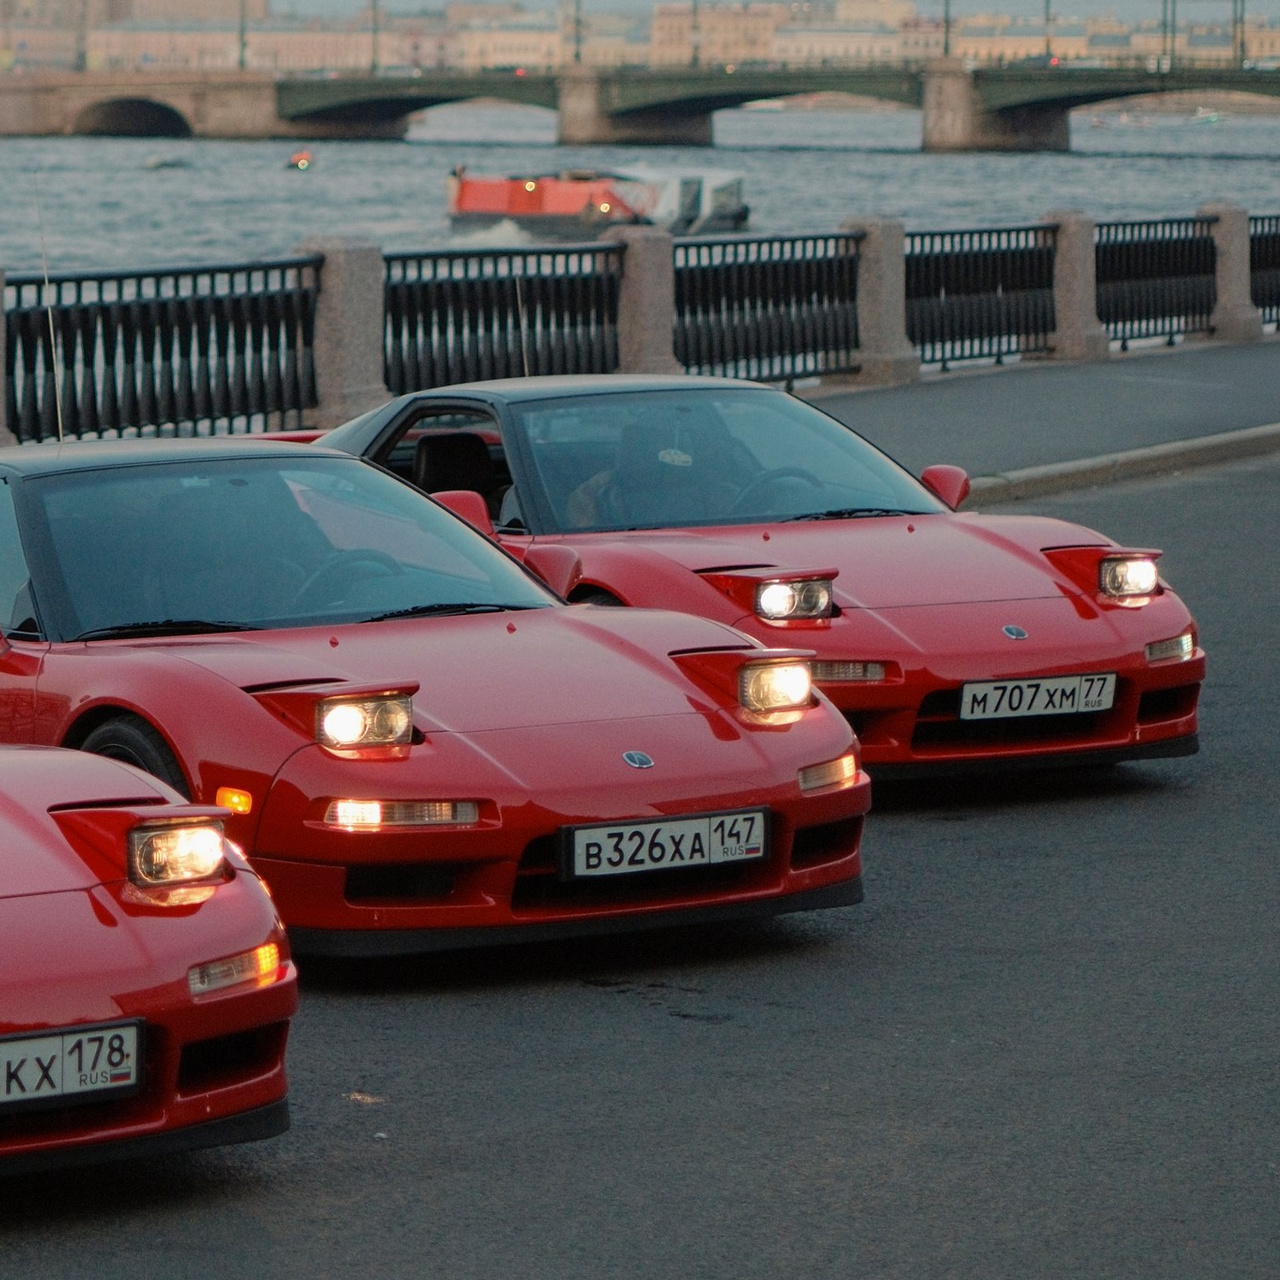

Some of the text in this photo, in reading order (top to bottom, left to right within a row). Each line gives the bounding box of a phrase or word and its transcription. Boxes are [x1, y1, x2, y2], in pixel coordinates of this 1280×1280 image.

[1084, 677, 1107, 699] 77
[1083, 699, 1102, 708] RUS
[713, 816, 755, 847] 147
[722, 845, 745, 858] RUS
[67, 1033, 125, 1074] 178
[78, 1072, 109, 1087] RUS
